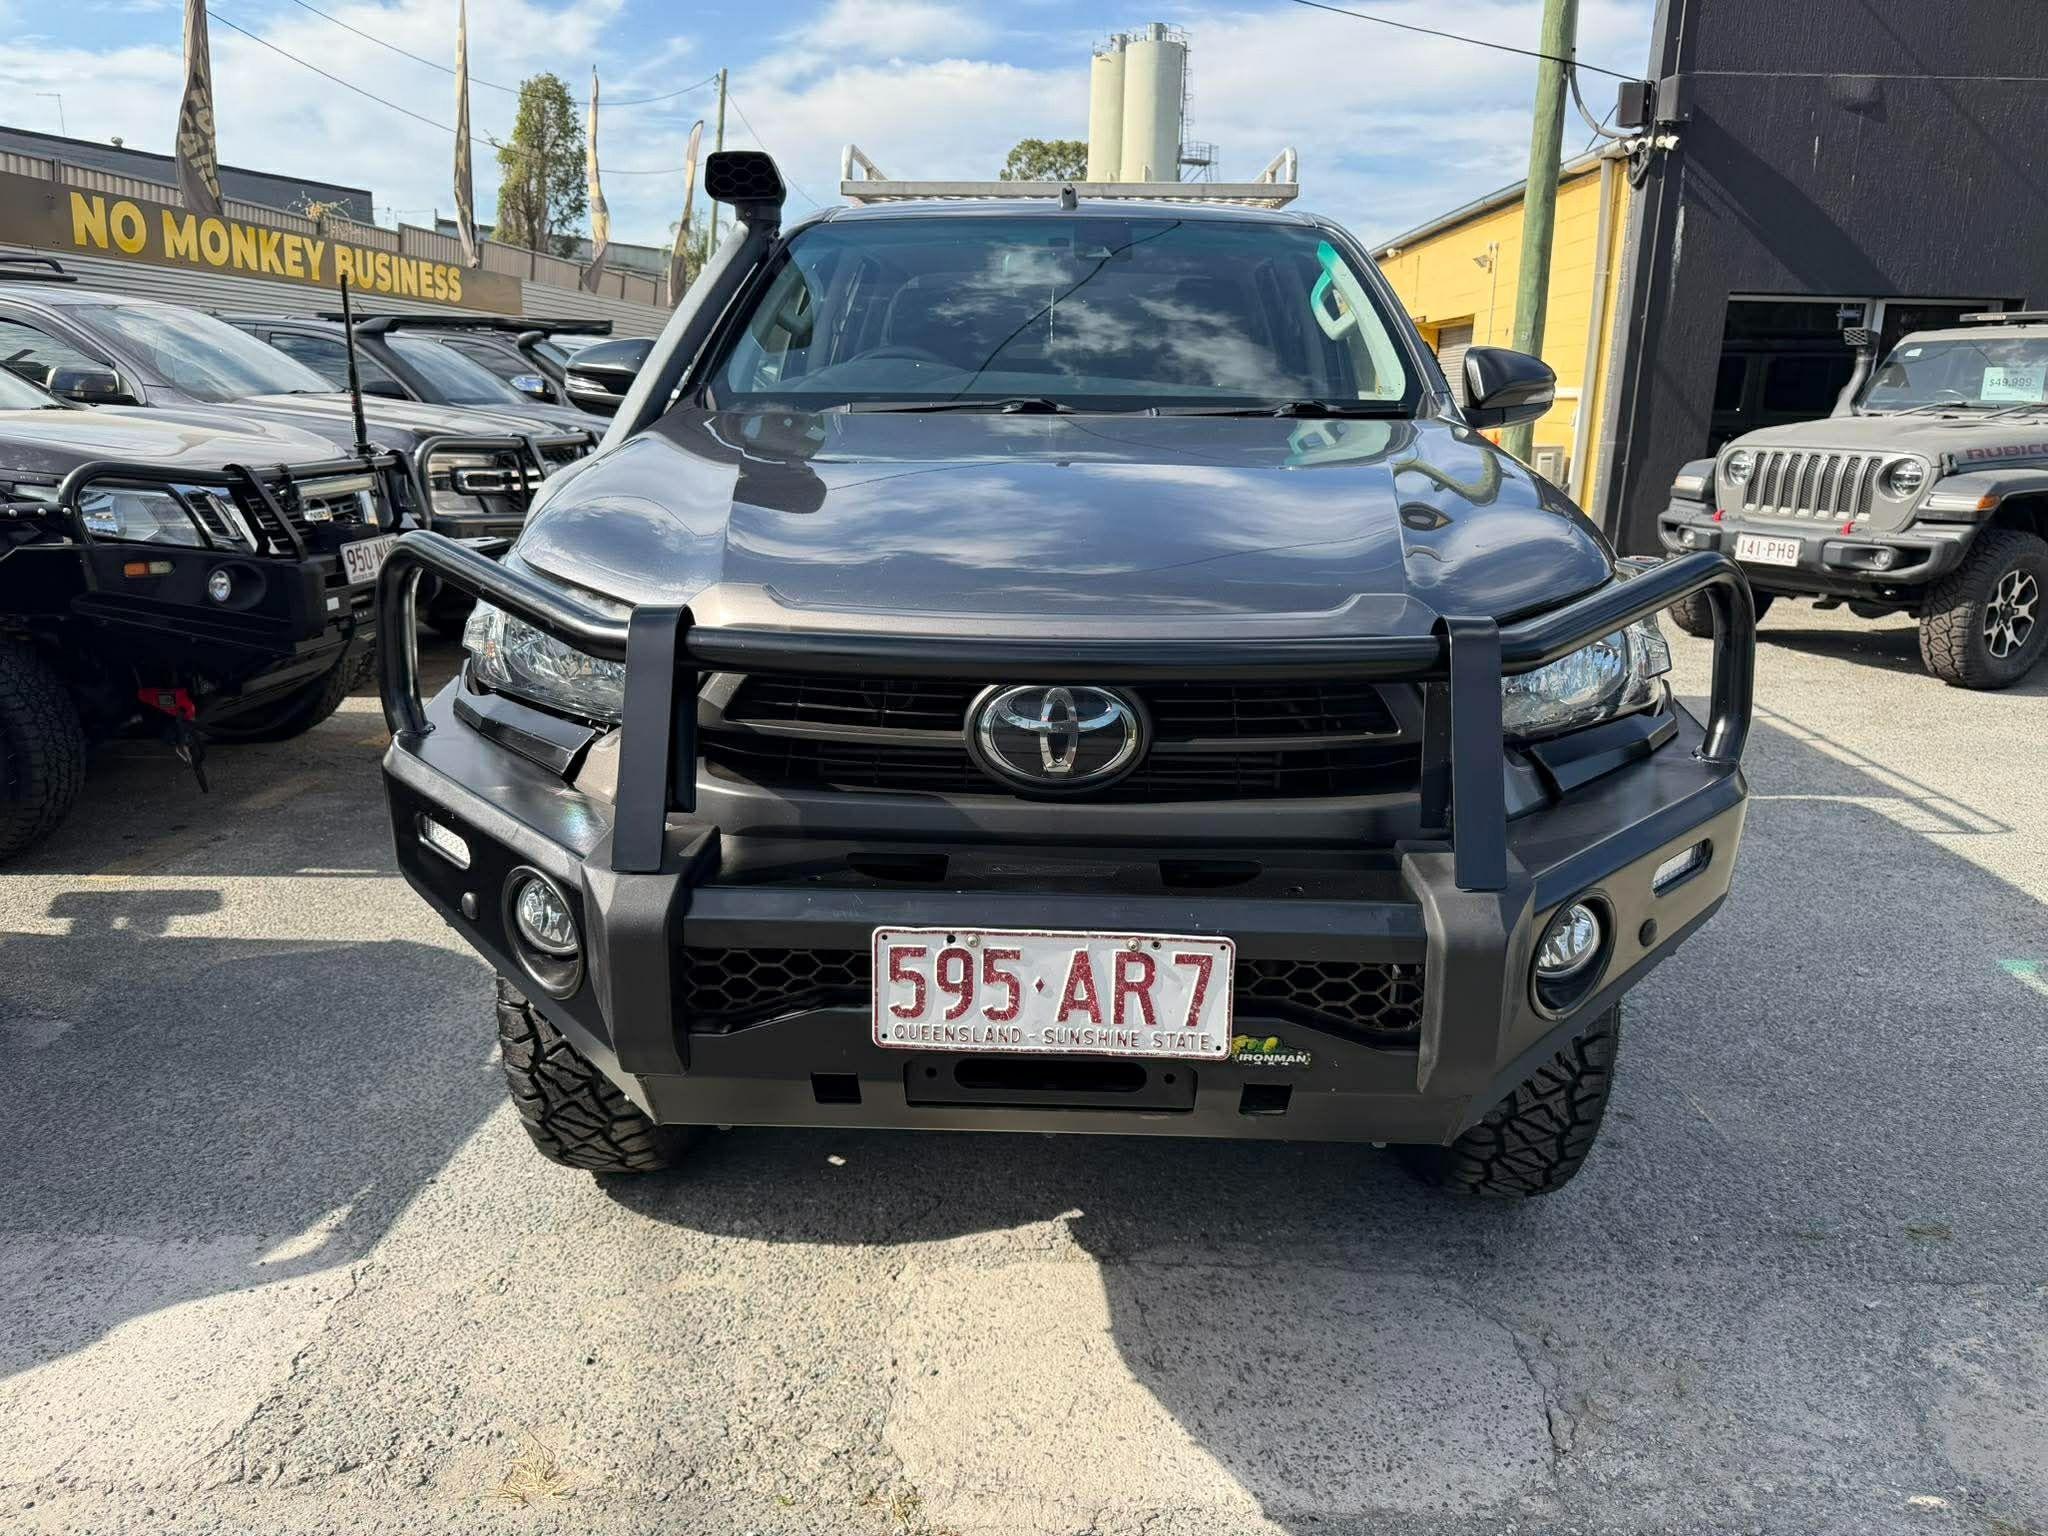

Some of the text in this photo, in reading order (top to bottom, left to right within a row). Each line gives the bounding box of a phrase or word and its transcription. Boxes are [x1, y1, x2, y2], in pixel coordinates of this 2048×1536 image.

[70, 191, 462, 302] NO MONKEY BUSINESS
[893, 1024, 1021, 1044] QUEENSLAND
[1044, 1028, 1139, 1048] SUNSHINE
[1152, 1032, 1211, 1051] STATE
[1239, 1053, 1306, 1063] IRONMAN
